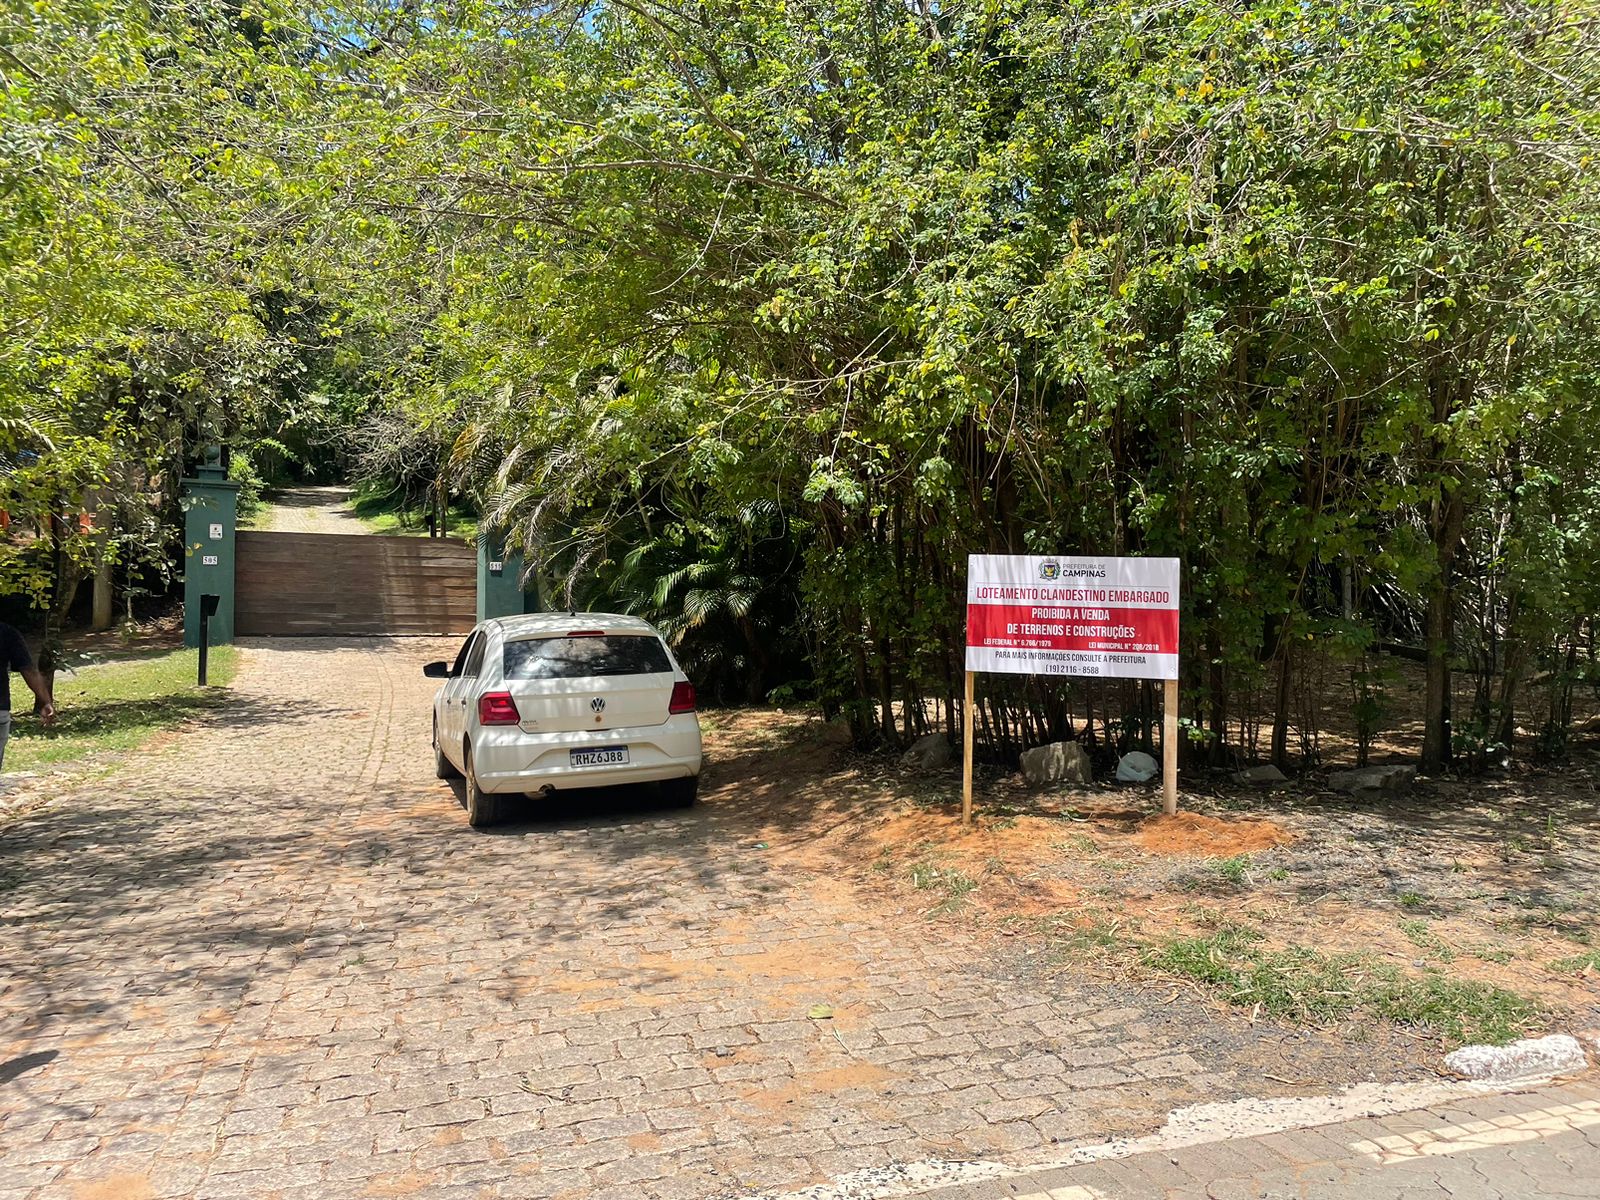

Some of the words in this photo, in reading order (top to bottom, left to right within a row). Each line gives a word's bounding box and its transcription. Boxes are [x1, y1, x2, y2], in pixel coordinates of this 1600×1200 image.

[204, 556, 217, 564] 505
[1062, 569, 1106, 578] CAMPINAS
[976, 587, 1038, 600] LOTEAMENTO
[1040, 588, 1106, 602] CLANDESTINO
[1108, 590, 1169, 603] EMBARGADO
[1031, 607, 1071, 619] PROIBIDA
[1073, 609, 1079, 620] A
[1081, 608, 1110, 620] VENDA
[1007, 623, 1018, 634] DE
[1020, 623, 1064, 636] TERRENOS
[1065, 625, 1071, 636] E
[1073, 624, 1136, 639] CONSTRUÇÕES
[992, 638, 1012, 646] FEDERAL
[1097, 642, 1123, 650] MUNICIPAL
[995, 651, 1010, 659] PARA
[1012, 651, 1027, 660] MAIS
[1028, 651, 1070, 662] INFORMAÇÕES
[1071, 653, 1102, 662] CONSULTE
[1103, 655, 1108, 663] A
[1109, 655, 1146, 664] PREFEITURA
[1045, 664, 1060, 673] (19)
[1061, 665, 1077, 674] 2116
[1082, 666, 1099, 675] 8588
[576, 752, 623, 765] RHZ6J88
